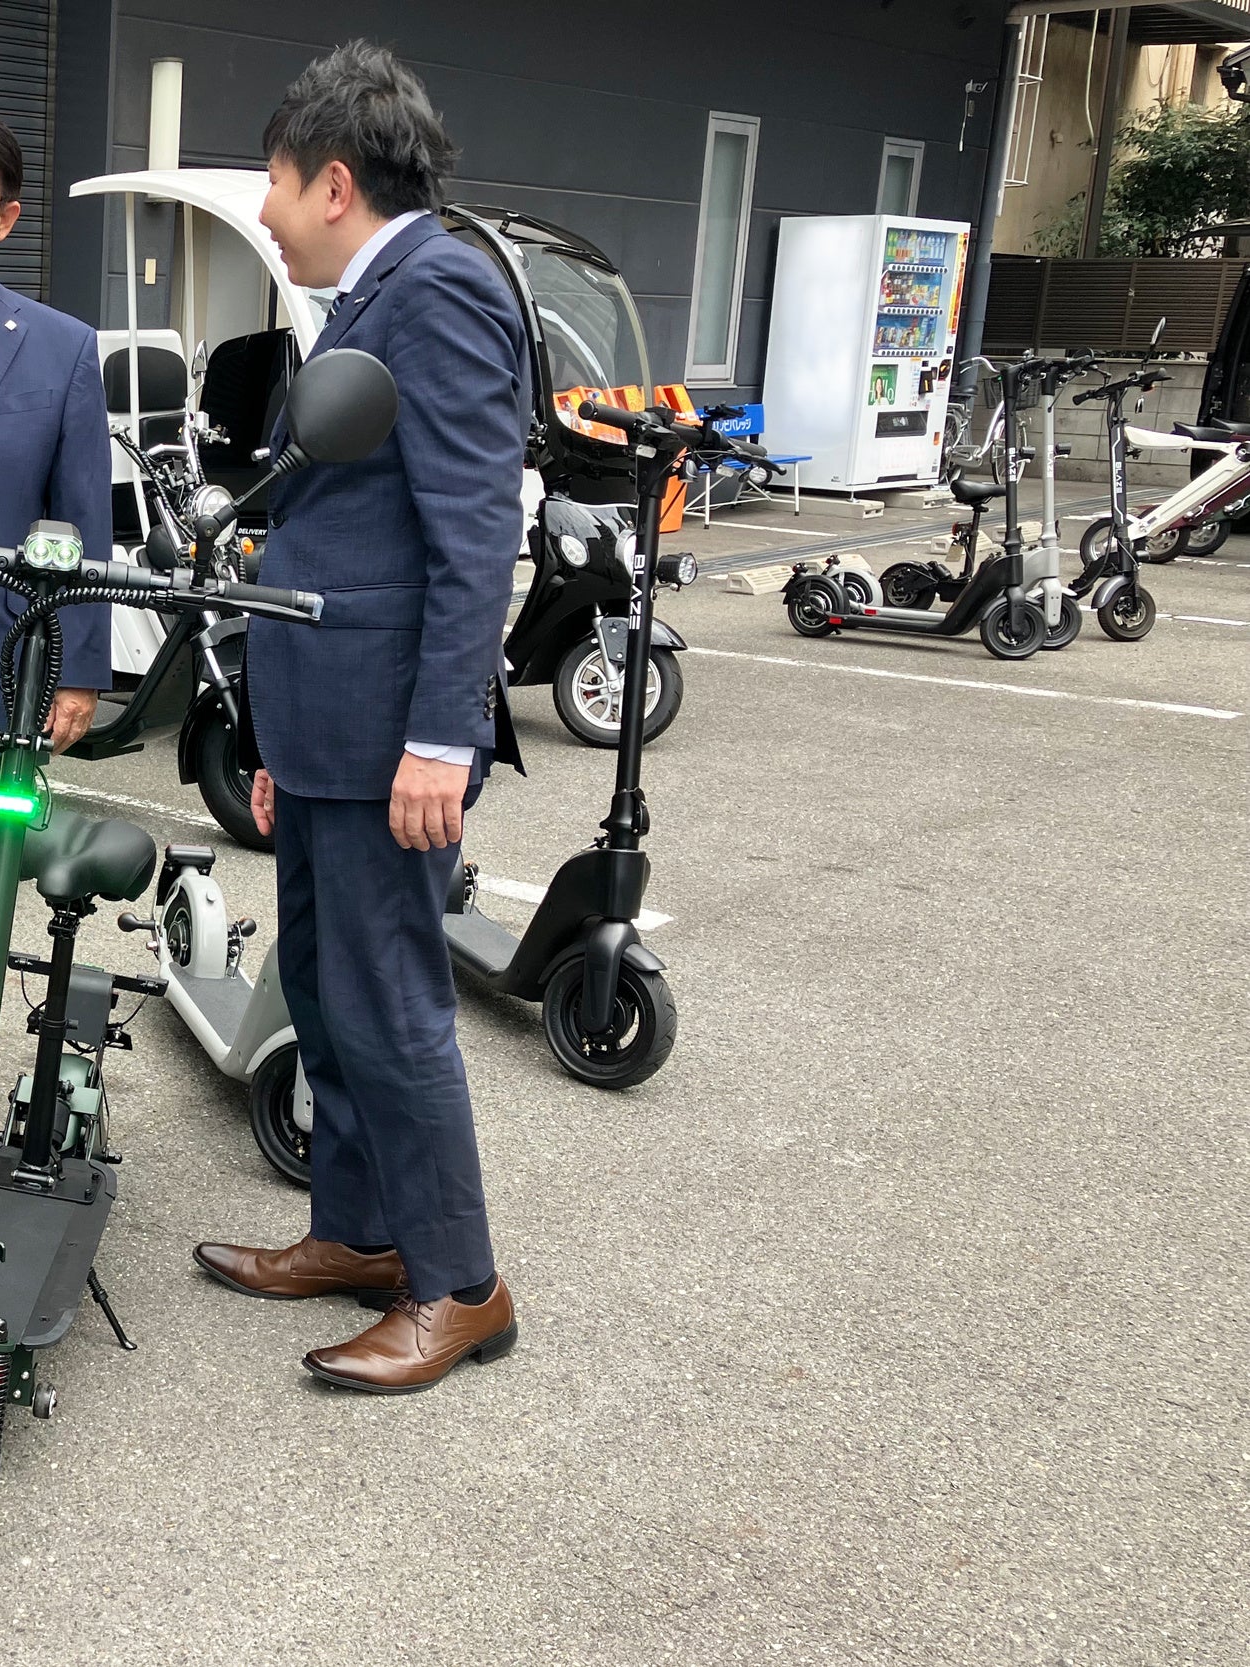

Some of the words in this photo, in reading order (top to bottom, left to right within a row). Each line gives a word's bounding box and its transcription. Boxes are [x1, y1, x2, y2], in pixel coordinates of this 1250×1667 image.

[712, 418, 752, 432] リンビバレッジ
[1008, 447, 1017, 482] BLAZE
[1115, 461, 1123, 493] BLAZE
[237, 527, 268, 536] DELIVERY
[628, 554, 646, 630] BLAZE
